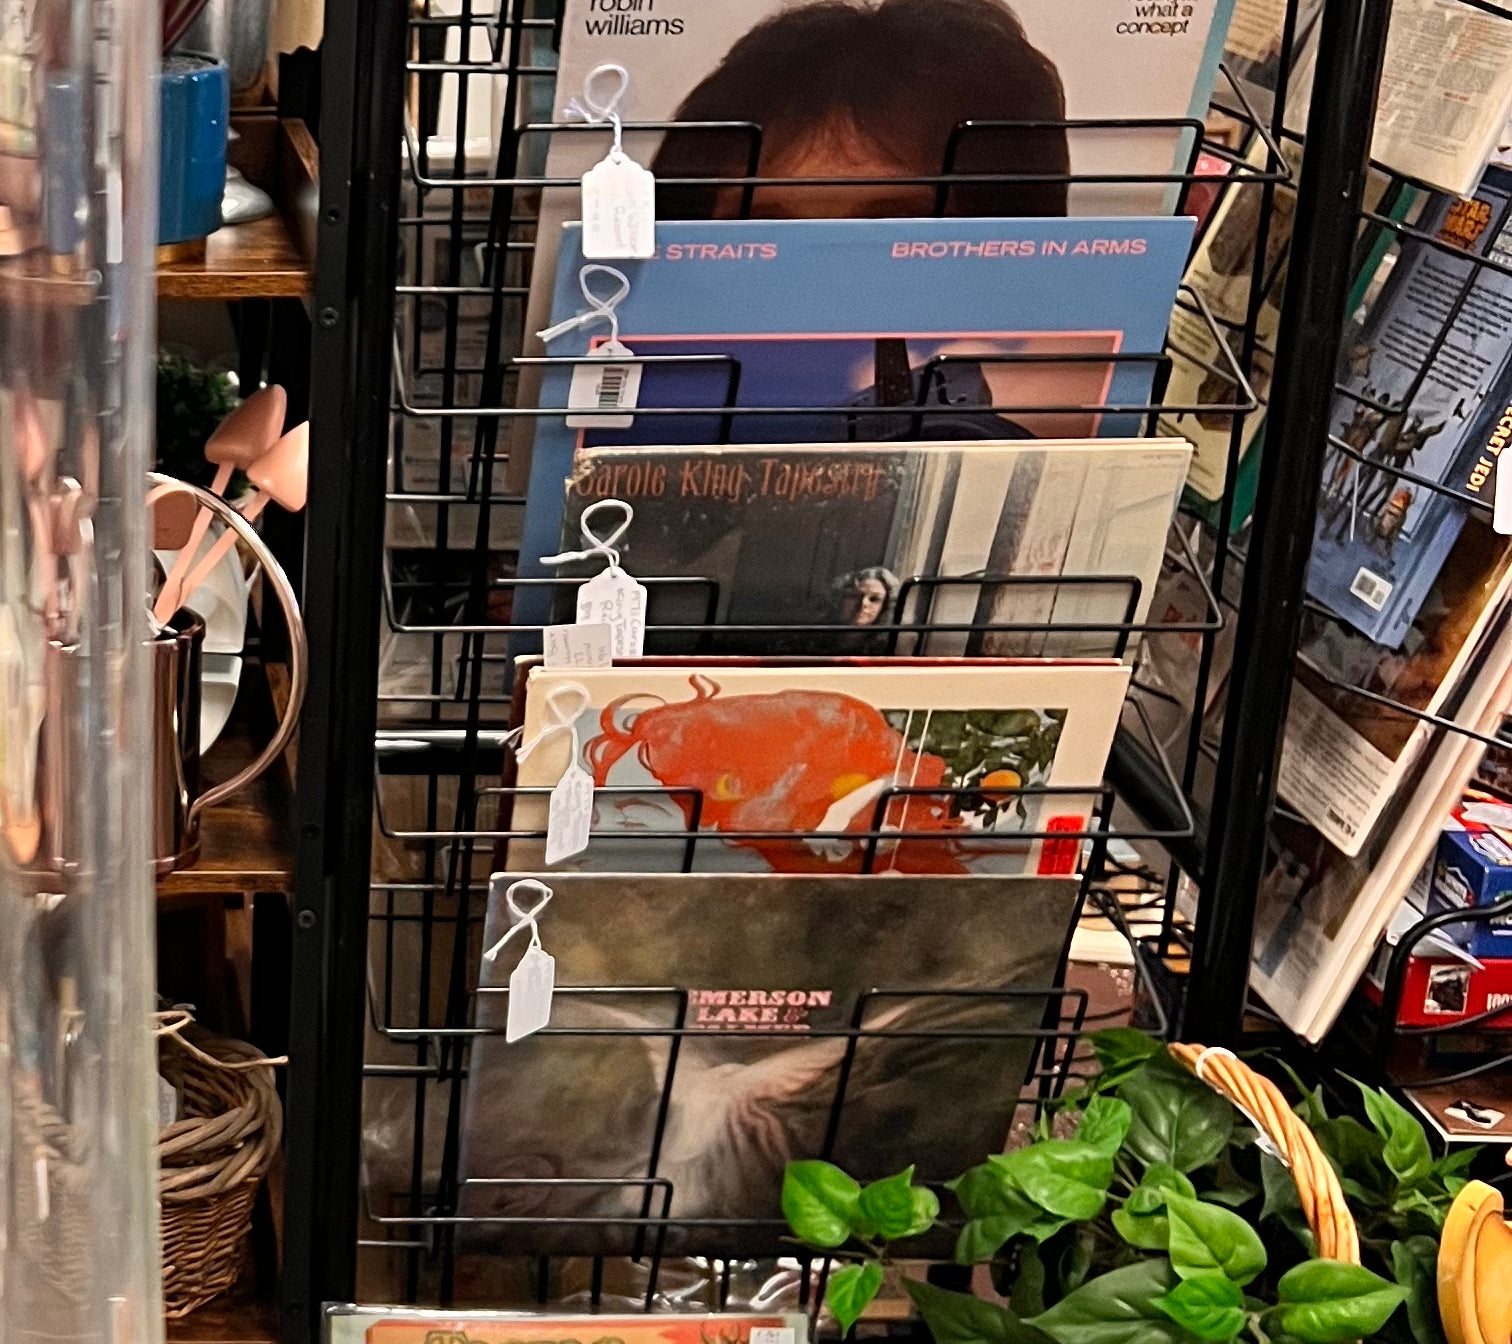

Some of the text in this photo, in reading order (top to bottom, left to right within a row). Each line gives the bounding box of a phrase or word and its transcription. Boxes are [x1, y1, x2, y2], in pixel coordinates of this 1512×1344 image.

[1135, 2, 1194, 17] what a
[585, 14, 684, 35] williams
[1116, 20, 1189, 37] concept
[665, 243, 778, 261] STRAITS
[892, 241, 1035, 259] BROTHERS
[1041, 240, 1068, 257] IN
[1071, 238, 1147, 256] ARMS
[1465, 401, 1512, 494] ECRET JEDI
[681, 459, 745, 501] King
[760, 458, 884, 501] Tapestry
[696, 1006, 779, 1023] LAKE
